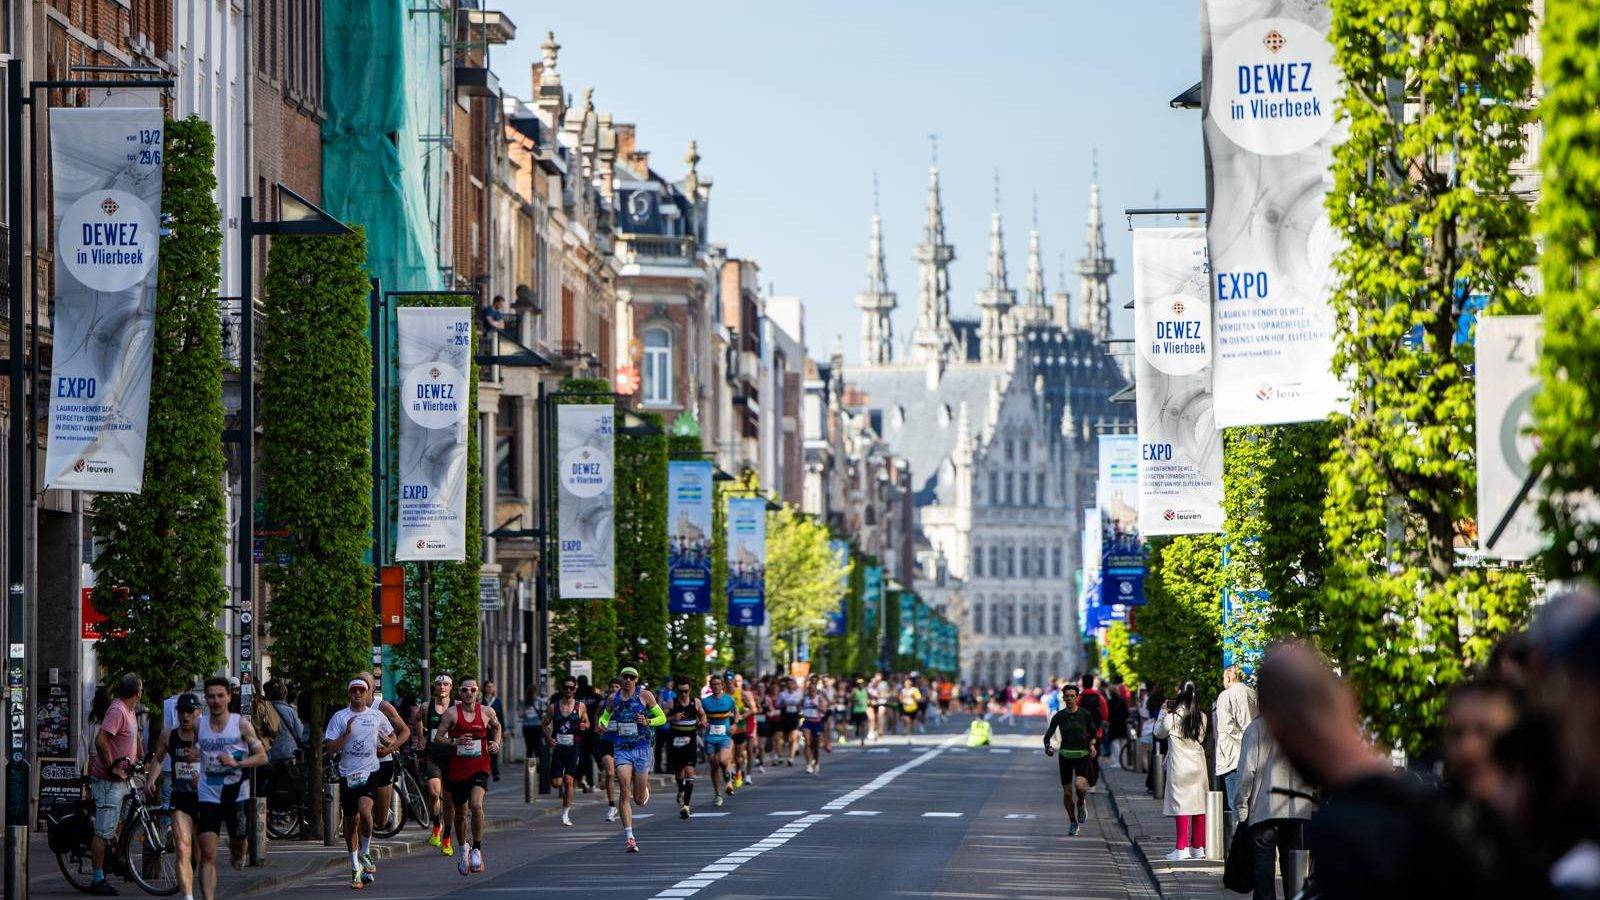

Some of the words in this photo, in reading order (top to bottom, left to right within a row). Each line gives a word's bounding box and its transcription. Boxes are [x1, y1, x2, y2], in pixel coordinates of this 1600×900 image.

[1238, 62, 1313, 95] DEWEZ
[1231, 99, 1244, 120] in
[1250, 96, 1321, 119] Vlierbeek
[139, 129, 161, 145] 13/2
[139, 149, 161, 165] 29/6
[82, 222, 139, 246] DEWEZ
[76, 248, 88, 265] in
[91, 248, 144, 265] Vlierbeek
[1217, 271, 1268, 300] EXPO
[455, 322, 469, 333] 13/2
[1156, 321, 1201, 339] DEWEZ
[454, 335, 469, 346] 29/6
[1152, 341, 1160, 354] in
[1163, 341, 1206, 354] Vlierbeek
[57, 377, 96, 399] EXPO
[417, 383, 454, 399] DEWEZ
[413, 400, 421, 412] in
[423, 400, 458, 412] Vlierbeek
[1142, 443, 1172, 461] EXPO
[86, 466, 113, 474] leuven
[572, 462, 600, 475] DEWEZ
[403, 485, 428, 500] EXPO
[1176, 512, 1202, 520] leuven
[562, 540, 582, 551] EXPO
